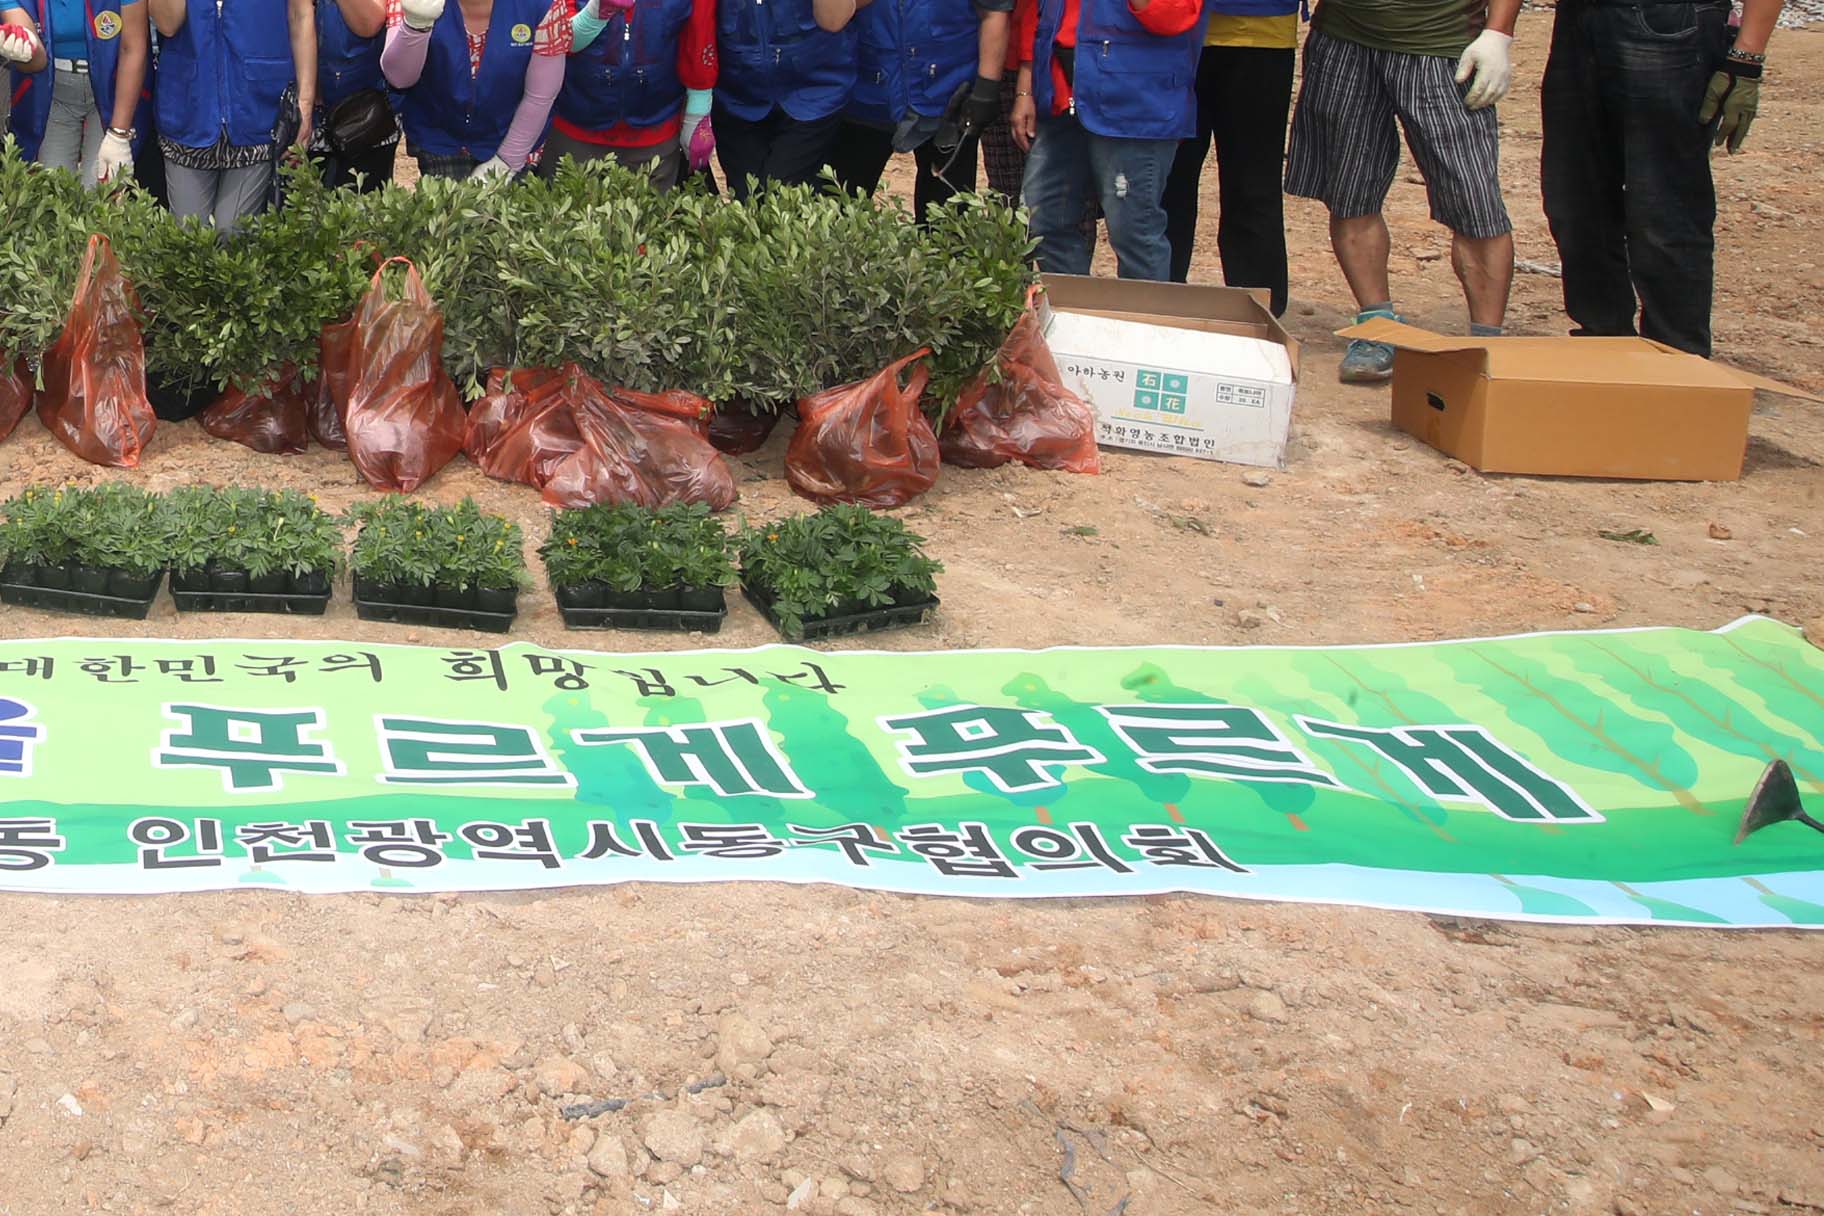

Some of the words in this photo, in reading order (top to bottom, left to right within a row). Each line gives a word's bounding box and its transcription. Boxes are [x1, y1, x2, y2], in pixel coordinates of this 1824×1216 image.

[1067, 365, 1125, 382] 아하농원
[1143, 373, 1157, 387] 石
[1166, 397, 1180, 411] 花
[158, 704, 808, 795] 푸르게
[881, 706, 1599, 820] 푸르게
[132, 819, 1251, 878] 인천광역시동구협의회
